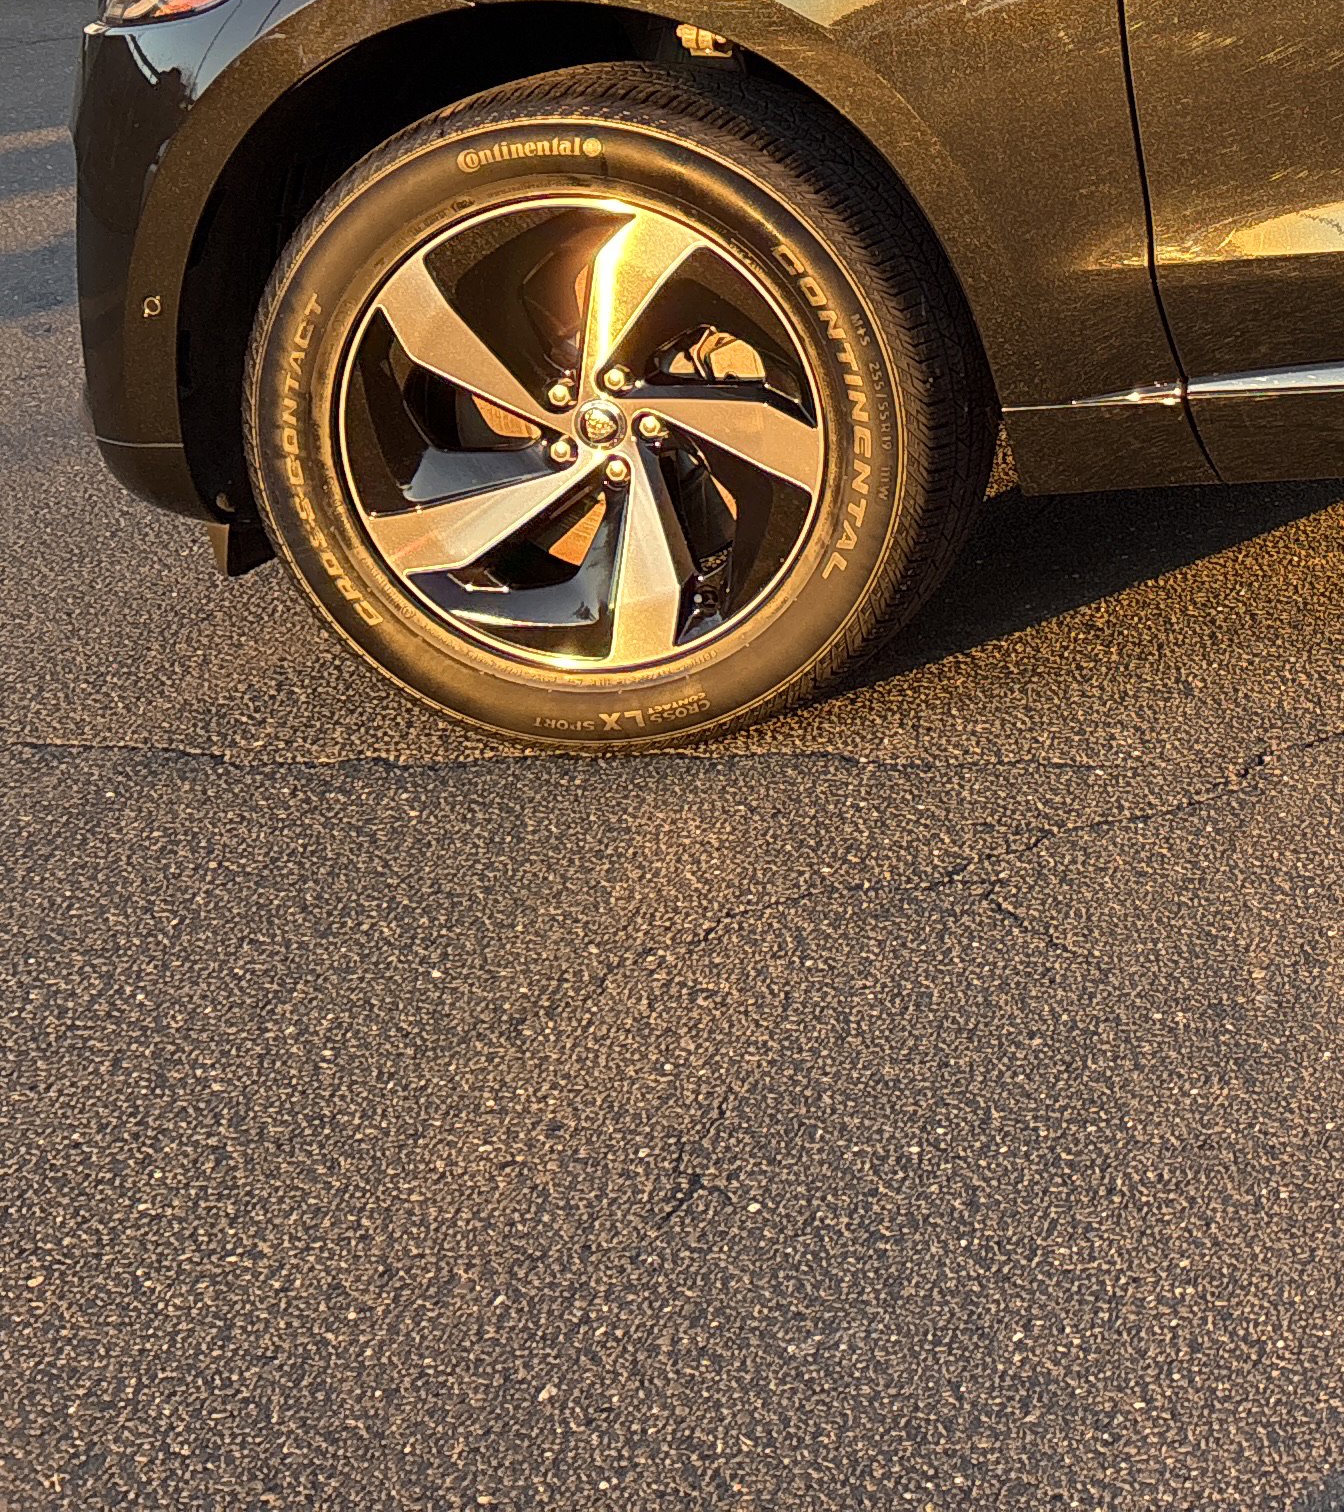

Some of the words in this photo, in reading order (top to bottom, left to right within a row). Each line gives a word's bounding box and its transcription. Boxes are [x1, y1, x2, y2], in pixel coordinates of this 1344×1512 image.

[457, 136, 581, 173] Continental
[771, 243, 871, 580] CONTINENTAL
[868, 361, 893, 451] 255/55R19
[647, 692, 706, 714] CONTACT
[650, 699, 711, 723] CROSS
[534, 716, 595, 732] SPORT
